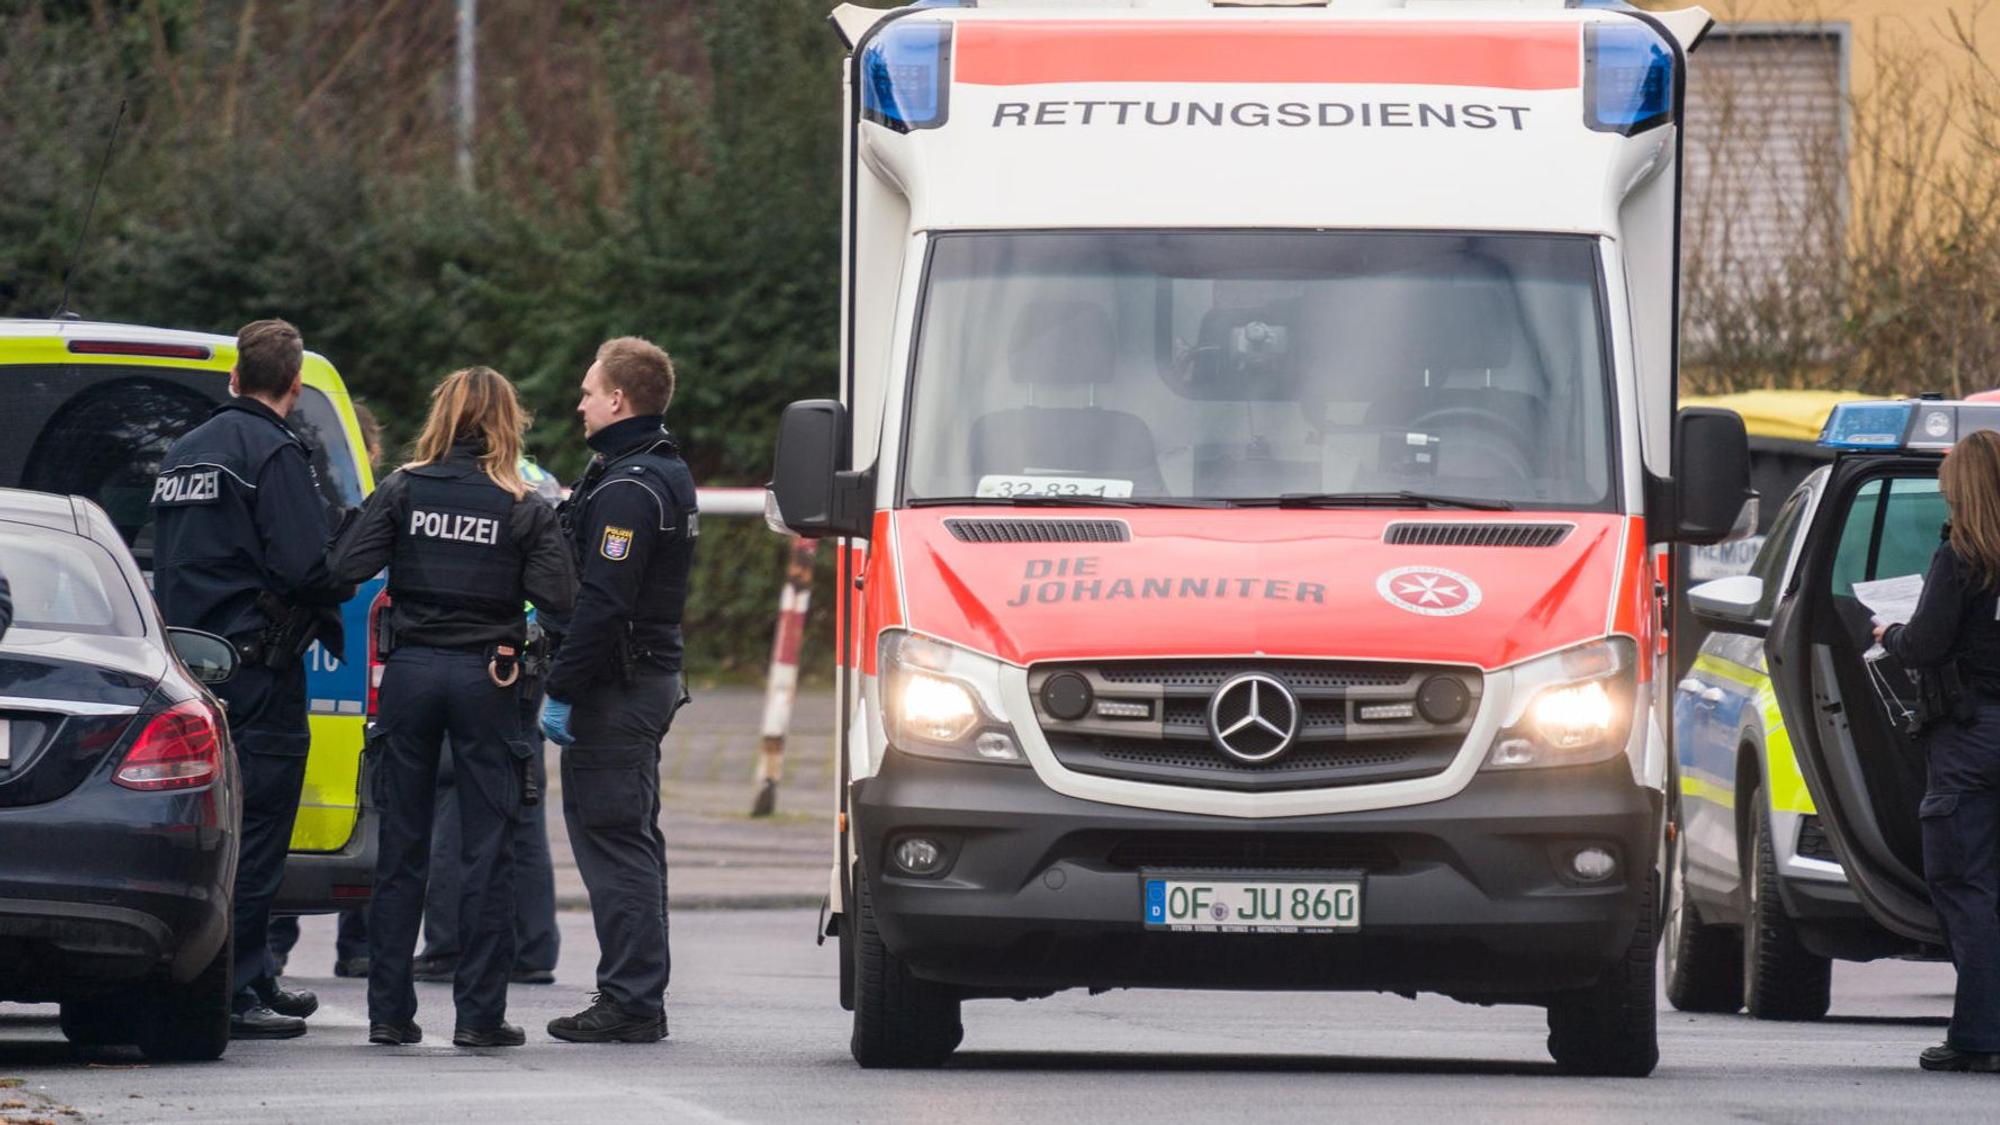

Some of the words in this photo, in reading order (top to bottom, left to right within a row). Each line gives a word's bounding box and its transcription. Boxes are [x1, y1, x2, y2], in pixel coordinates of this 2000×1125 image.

[992, 101, 1531, 130] RETTUNGSDIENST
[150, 471, 219, 503] POLIZEI
[410, 510, 499, 545] POLIZEI
[1025, 556, 1099, 580] DIE
[1007, 577, 1326, 606] JOHANNITER
[1169, 887, 1213, 919] OF
[1238, 888, 1281, 920] JU
[1291, 888, 1354, 921] 860
